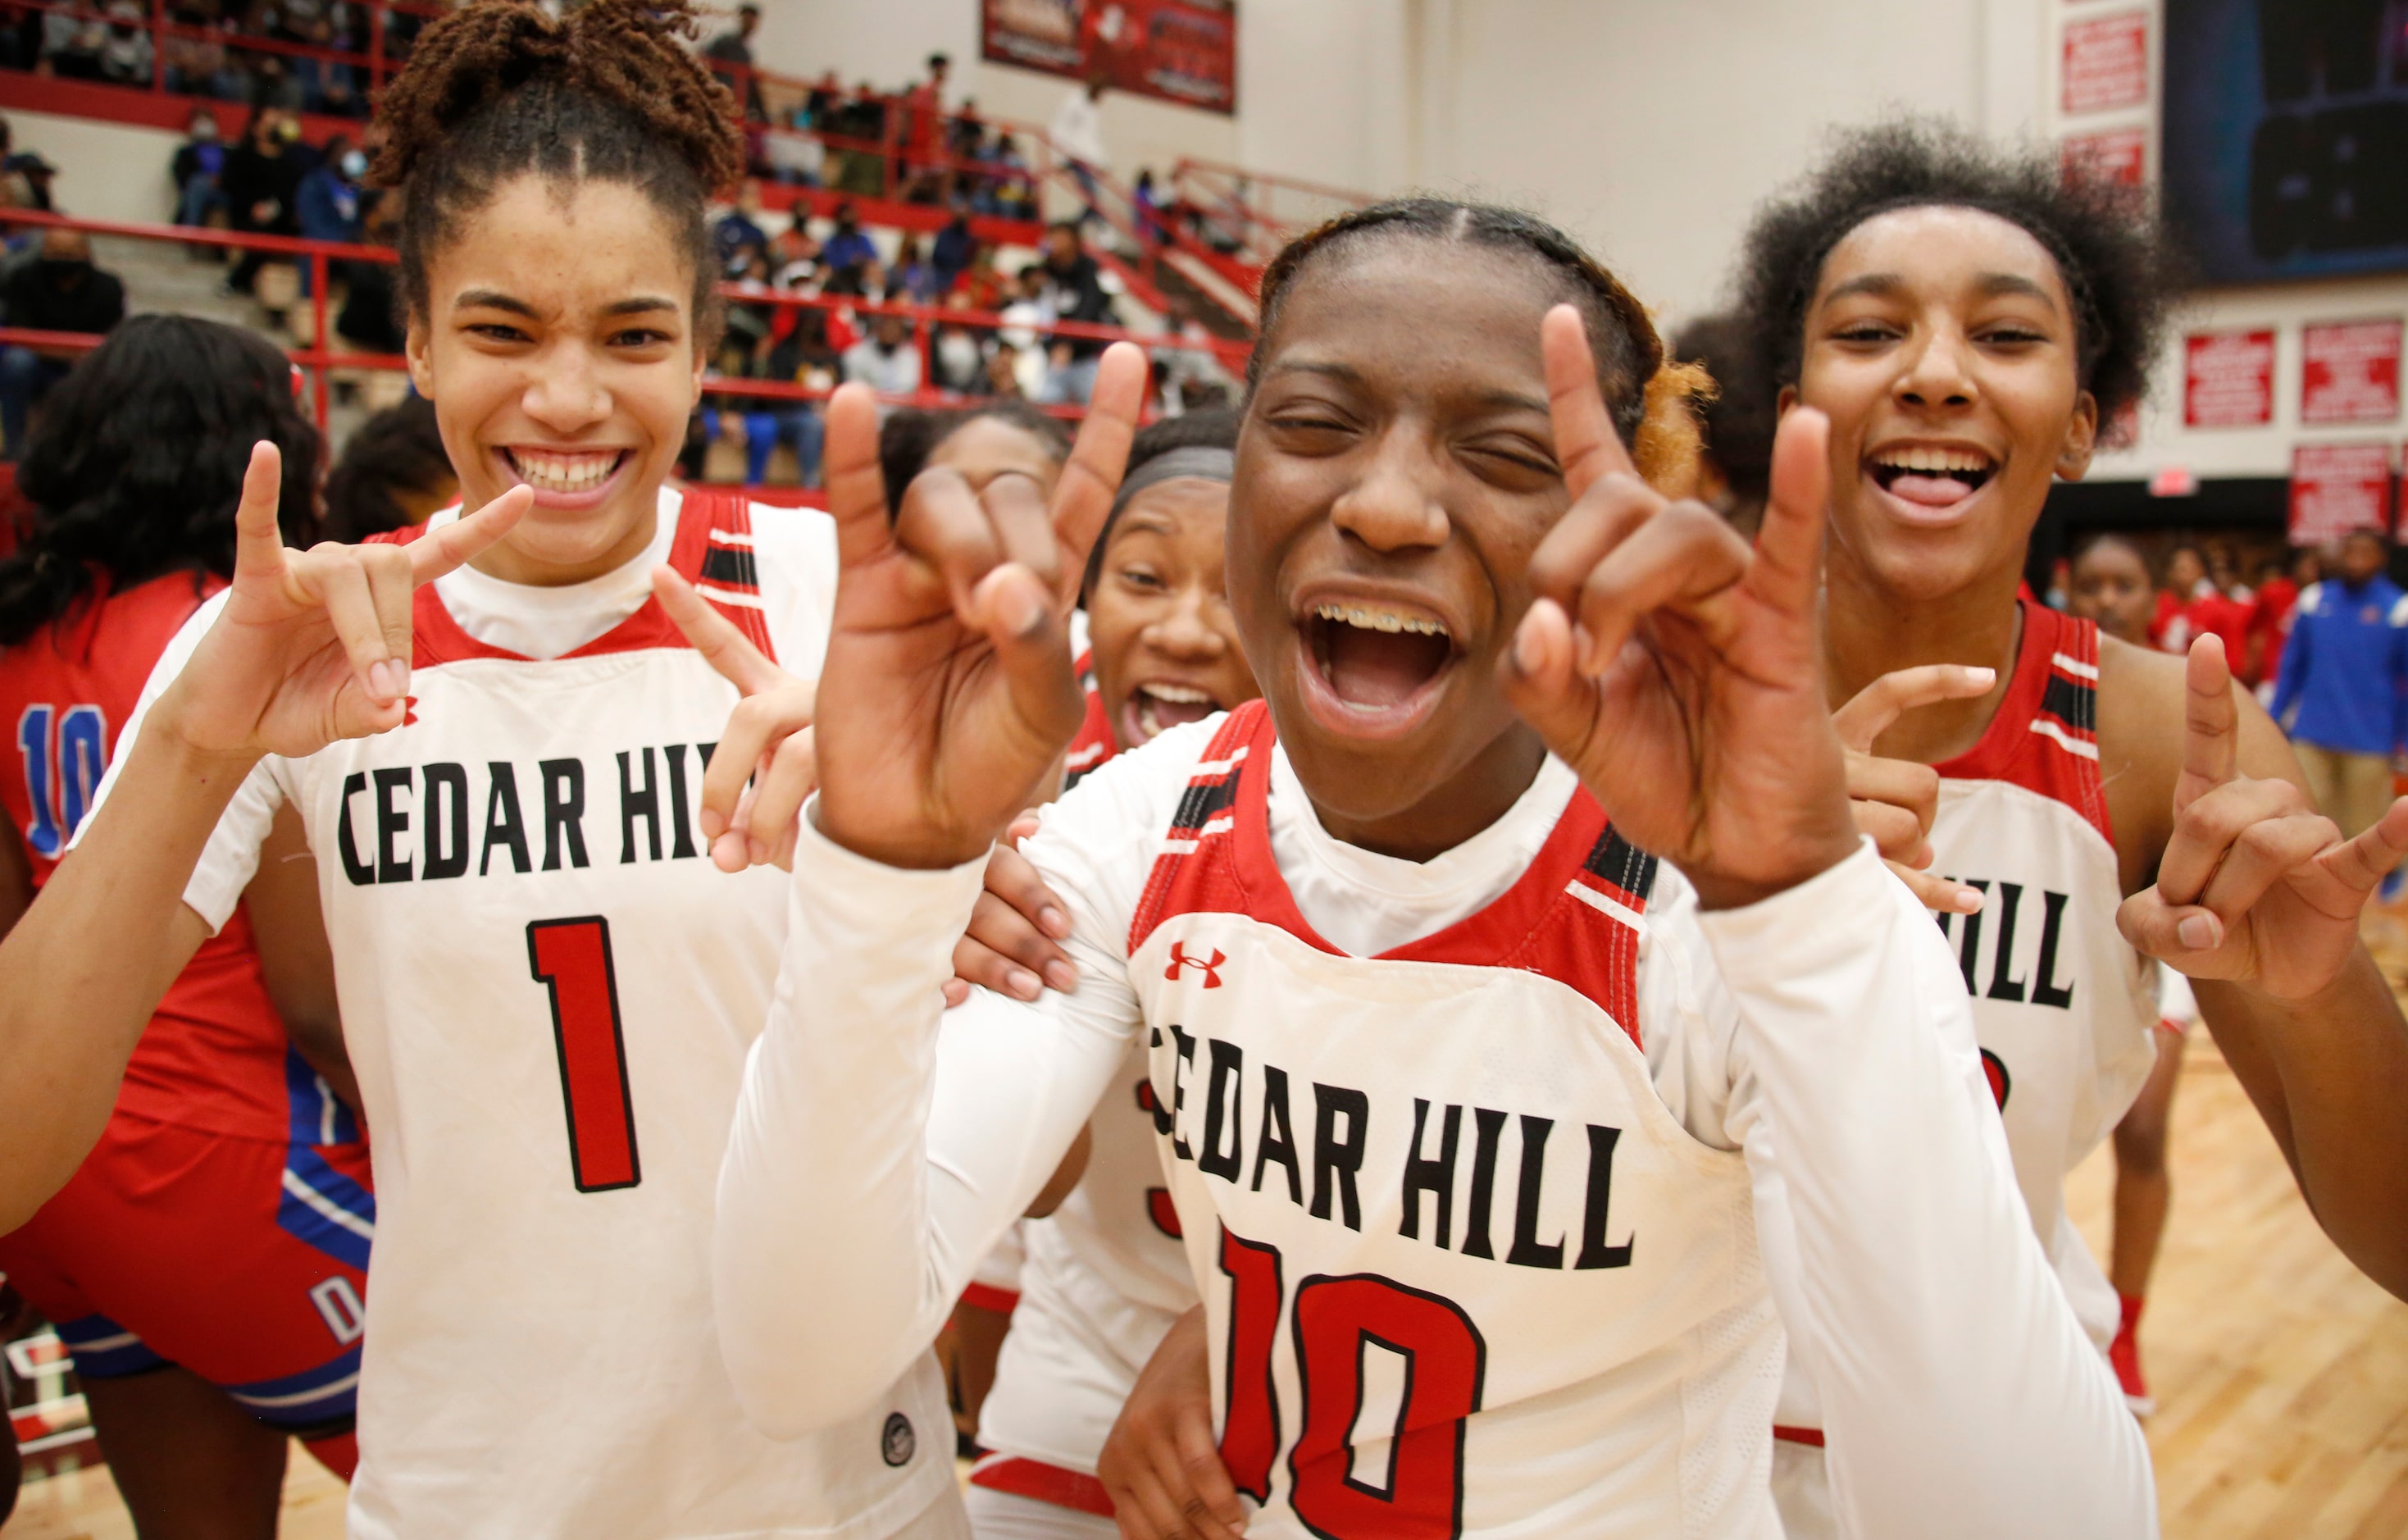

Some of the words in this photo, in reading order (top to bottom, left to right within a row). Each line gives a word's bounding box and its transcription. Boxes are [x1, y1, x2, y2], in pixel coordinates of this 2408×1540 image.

[17, 704, 107, 859] 10
[338, 758, 590, 886] CEDAR
[616, 742, 756, 864] HI
[526, 914, 642, 1193] 1
[1398, 1097, 1636, 1270] HILL
[307, 1274, 366, 1345] D
[1218, 1214, 1486, 1540] 10
